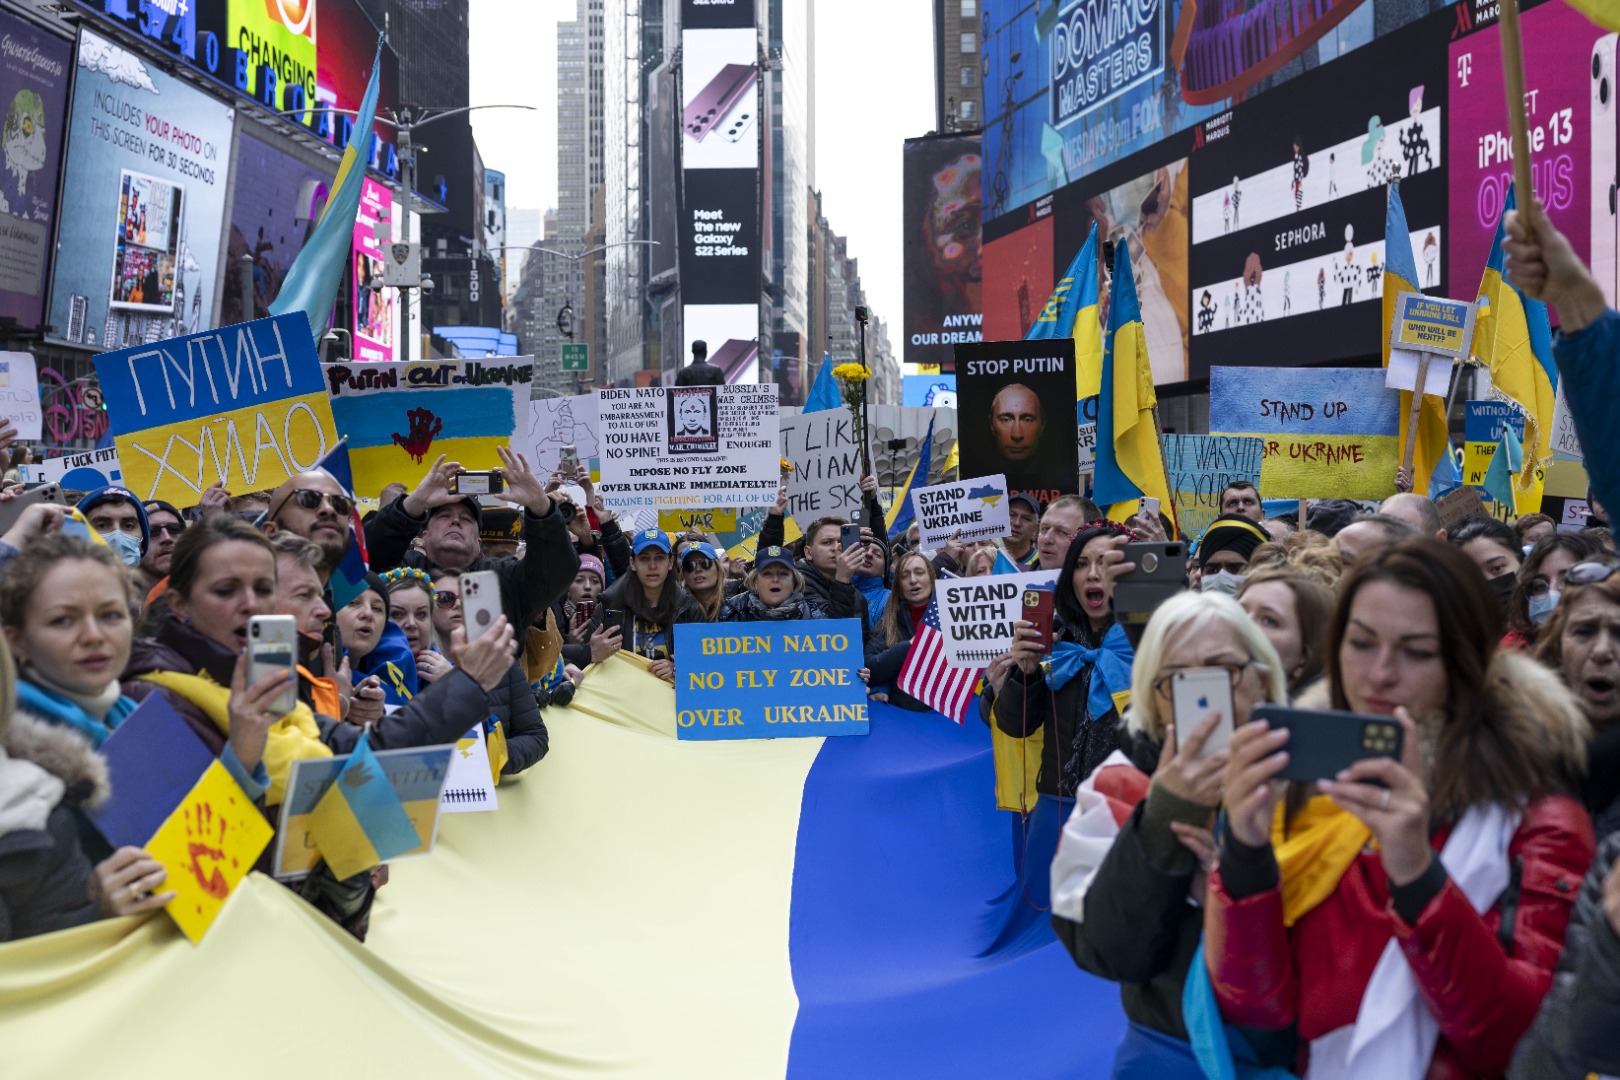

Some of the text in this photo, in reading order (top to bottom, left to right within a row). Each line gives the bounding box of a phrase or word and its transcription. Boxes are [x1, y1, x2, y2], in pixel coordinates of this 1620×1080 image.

[239, 26, 315, 100] CHANGING
[1059, 32, 1152, 118] MASTERS
[235, 48, 414, 177] BROADA
[1131, 94, 1165, 139] FOX
[94, 89, 218, 161] INCLUDES YOUR PHOTO ON
[1205, 125, 1231, 143] MARQUIS
[1478, 107, 1573, 169] iPhe 13
[90, 117, 215, 185] THIS SCREEN FOR 30 SECONDS
[694, 209, 723, 220] Meet
[694, 221, 741, 232] the new
[694, 233, 734, 246] Galaxy
[1274, 221, 1326, 251] SEPHORA
[695, 245, 749, 256] S22 Series
[470, 259, 479, 301] 1500
[1409, 308, 1442, 319] UKRAINE
[1425, 303, 1440, 311] YOU
[1442, 306, 1456, 314] LET
[1408, 323, 1426, 332] WHO
[1427, 326, 1445, 335] WILL
[911, 333, 938, 346] OUR
[128, 320, 292, 415] ПУТИН
[967, 357, 1064, 375] STOP PUTIN
[600, 388, 665, 399] BIDEN NATO
[723, 385, 770, 394] RUSSIA'S
[612, 402, 627, 410] YOU
[644, 401, 655, 409] AN
[716, 395, 779, 404] WAR CRIMES:
[600, 411, 664, 421] EMBARRASSMENT
[1260, 399, 1348, 424] STAND UP
[620, 421, 633, 429] ALL
[646, 420, 658, 428] US!
[605, 432, 661, 444] YOU HAVE
[726, 440, 772, 449] ENOUGH!
[63, 447, 119, 469] FUCK PUT
[606, 447, 660, 459] NO SPINE!
[1289, 442, 1365, 466] UKRAINE
[630, 465, 747, 477] IMPOSE NO FLY ZONE
[601, 480, 777, 492] OVER UKRAINE IMMEDIATELY!!!
[644, 497, 653, 505] IS
[654, 494, 701, 505] FIGHTING
[703, 494, 723, 503] FOR
[725, 494, 743, 503] ALL
[745, 494, 760, 503] OF
[762, 493, 776, 503] US
[788, 482, 860, 515] THE SK
[918, 487, 965, 505] STAND
[920, 501, 958, 517] WITH
[679, 513, 715, 529] WAR
[922, 510, 983, 530] UKRAINE
[946, 582, 1018, 604] STAND
[948, 603, 1006, 623] WITH
[701, 634, 849, 655] BIDEN NATO
[689, 668, 851, 690] NO FLY ZONE
[677, 704, 869, 728] OVER UKRAINE
